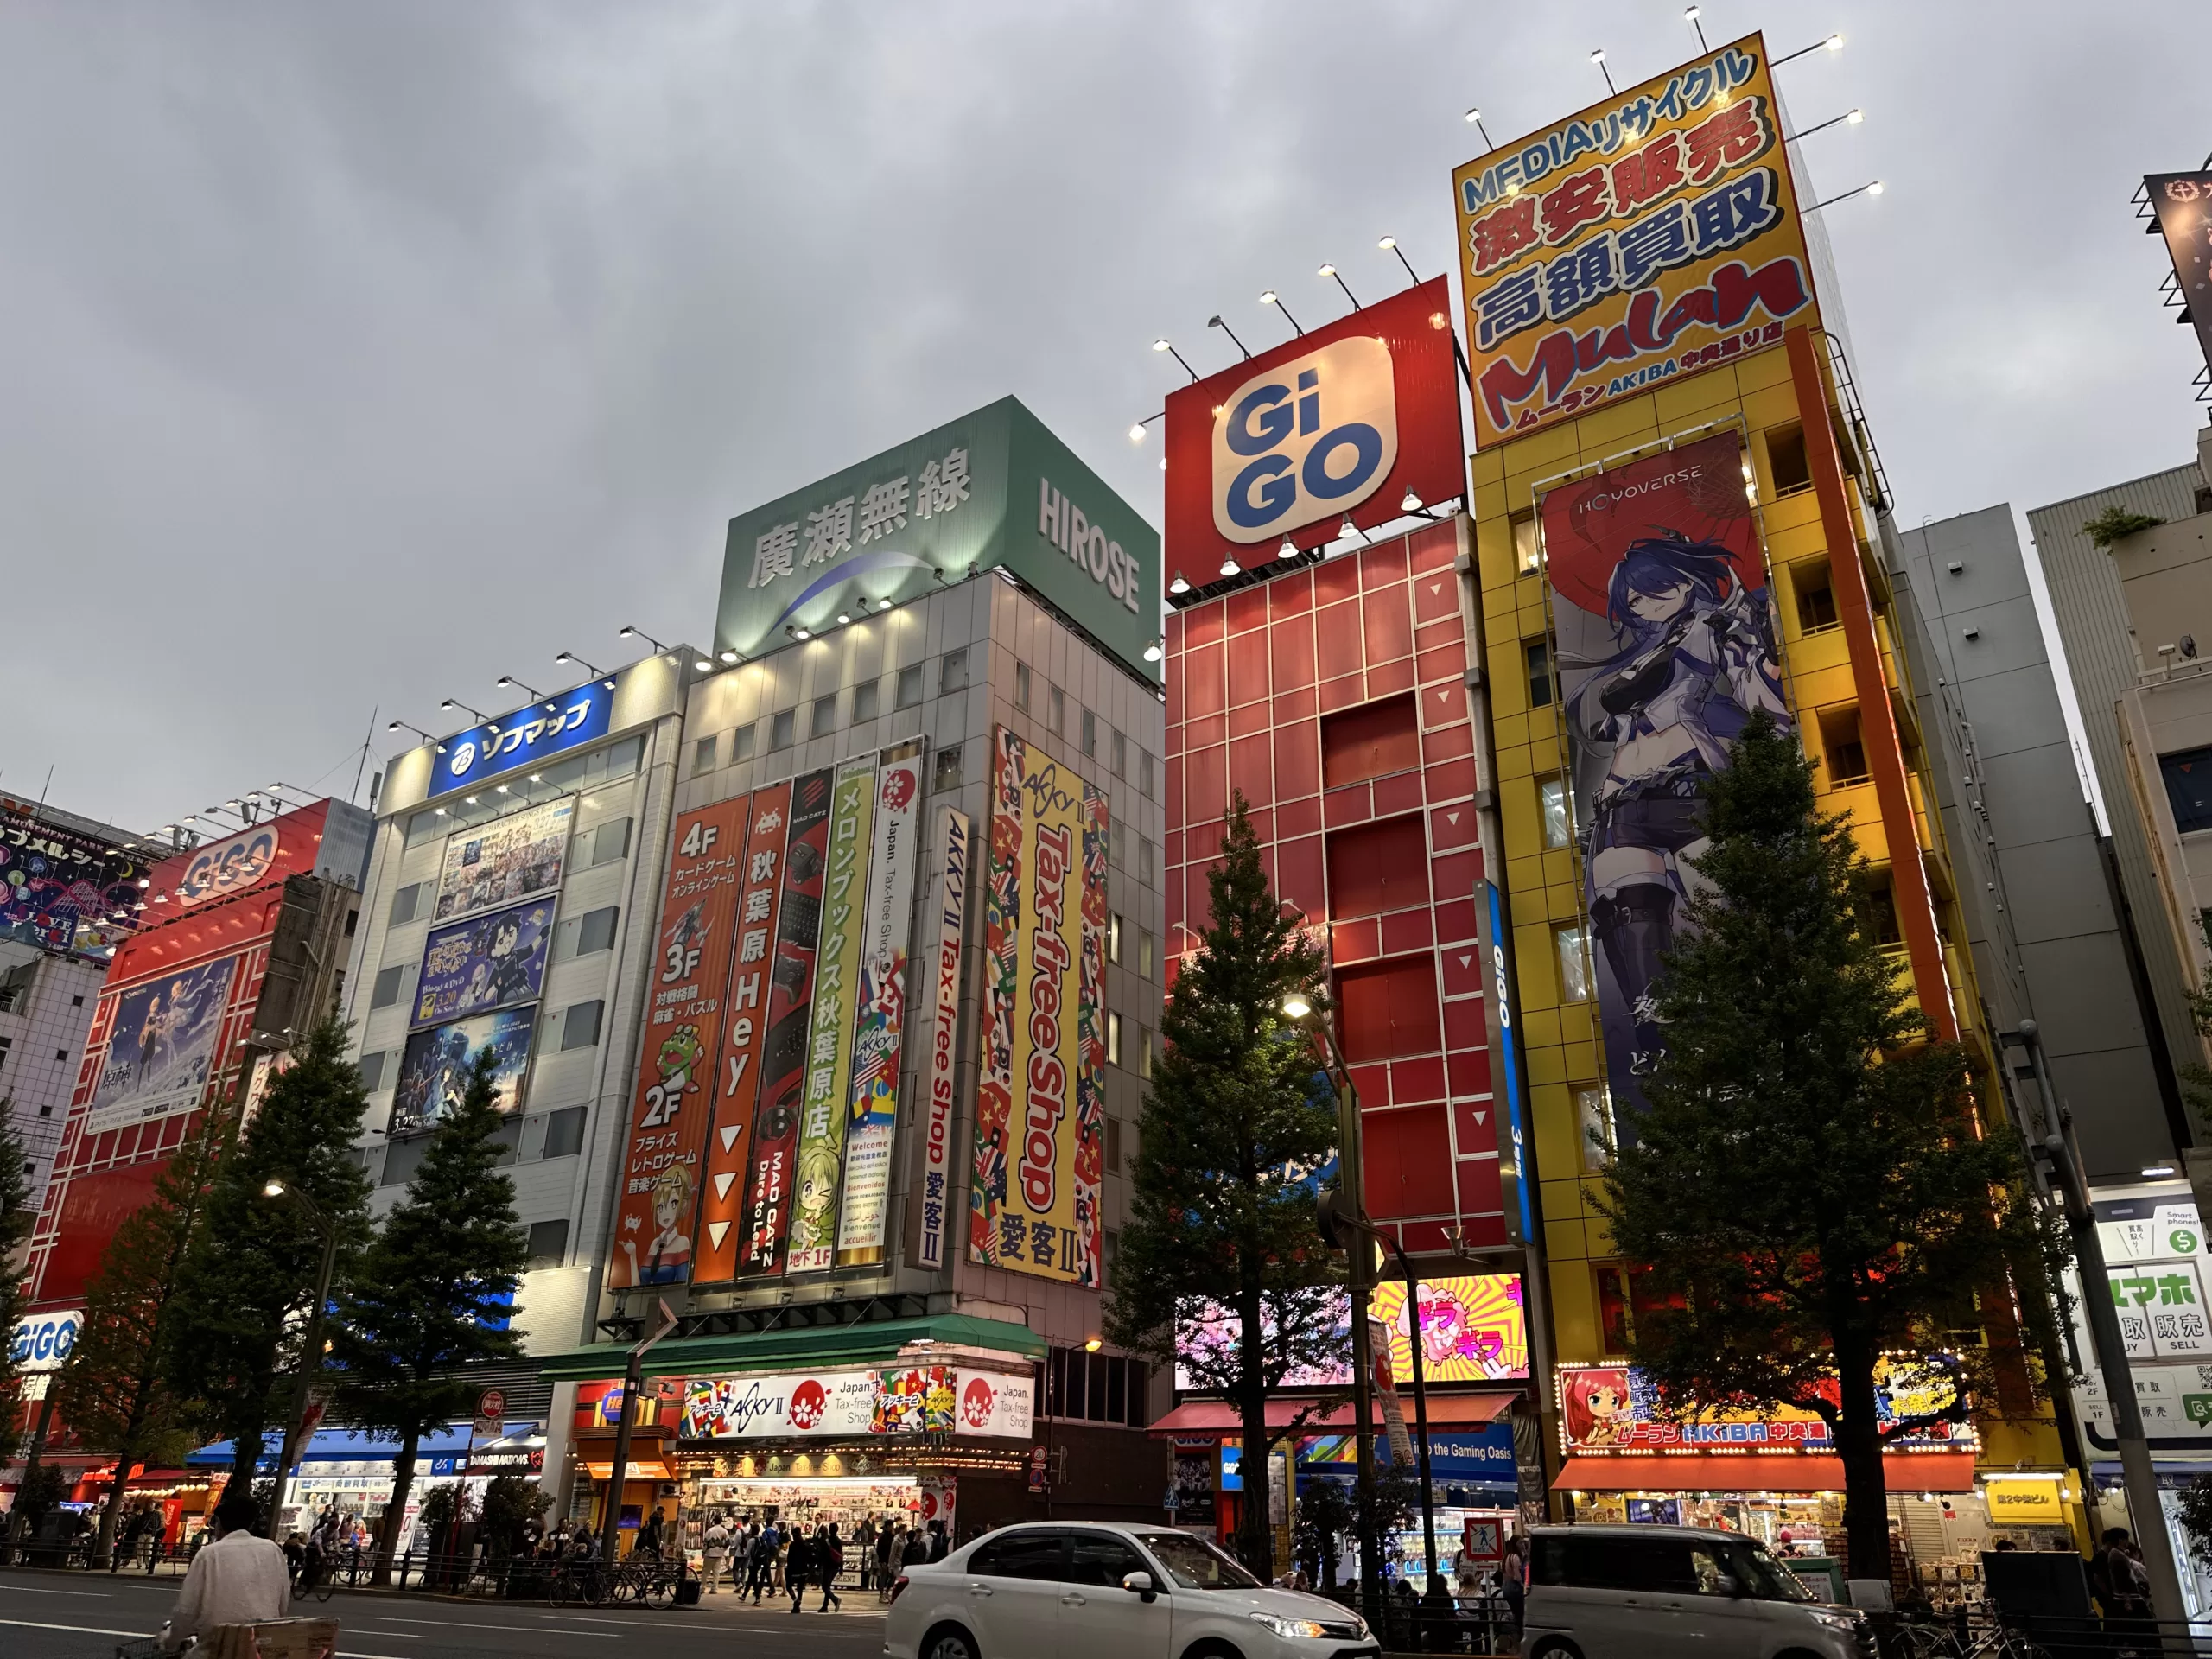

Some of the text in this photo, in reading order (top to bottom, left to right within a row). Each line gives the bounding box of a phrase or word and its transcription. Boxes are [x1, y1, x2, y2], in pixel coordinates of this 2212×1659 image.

[1471, 98, 1763, 271] 激安販売
[1475, 169, 1777, 349] 高額買取
[1479, 258, 1811, 431] Mulan
[1226, 423, 1382, 528] GO
[1579, 464, 1703, 513] HOYOVERSE
[748, 448, 970, 588] 廣瀬無線
[1038, 477, 1140, 613] HIROSE
[482, 698, 592, 760] ソフマップ
[1022, 764, 1074, 818] AKKY
[809, 810, 827, 820] CATZ
[2, 816, 105, 852] AMUSEMENT PARK
[680, 821, 717, 859] 4F
[675, 855, 736, 881] カードゲーム
[947, 813, 966, 912] AKKY
[671, 873, 734, 899] オンラインゲーム
[882, 868, 895, 920] Tax-free
[879, 924, 892, 959] Shop
[661, 943, 701, 982] 3F
[805, 787, 861, 1139] メロンブックス秋葉原店
[655, 984, 699, 1005] 対戦格闘
[935, 938, 961, 1071] Tax-free
[639, 1085, 682, 1128] 2F
[928, 1076, 951, 1164] Shop
[632, 1148, 696, 1173] レトロゲーム
[851, 1141, 888, 1151] Welcome
[628, 1172, 683, 1195] 音楽ゲーム
[847, 1181, 886, 1192] Bienvenidos
[750, 1160, 769, 1261] Dare to Lead
[763, 1152, 783, 1267] MAD CATZ
[844, 1223, 881, 1232] Bienvenue
[844, 1232, 877, 1245] accueillir
[1457, 1331, 1503, 1360] ギラ
[2171, 1341, 2200, 1350] SELL
[730, 1381, 774, 1434] AKKY
[836, 1397, 872, 1410] Tax-free
[847, 1412, 871, 1427] Shop
[1000, 1401, 1029, 1414] Tax-free
[1010, 1415, 1028, 1428] Shop
[823, 1462, 841, 1472] Shop
[1433, 1441, 1449, 1456] the
[1451, 1442, 1486, 1461] Gaming
[1487, 1445, 1512, 1460] Oasis
